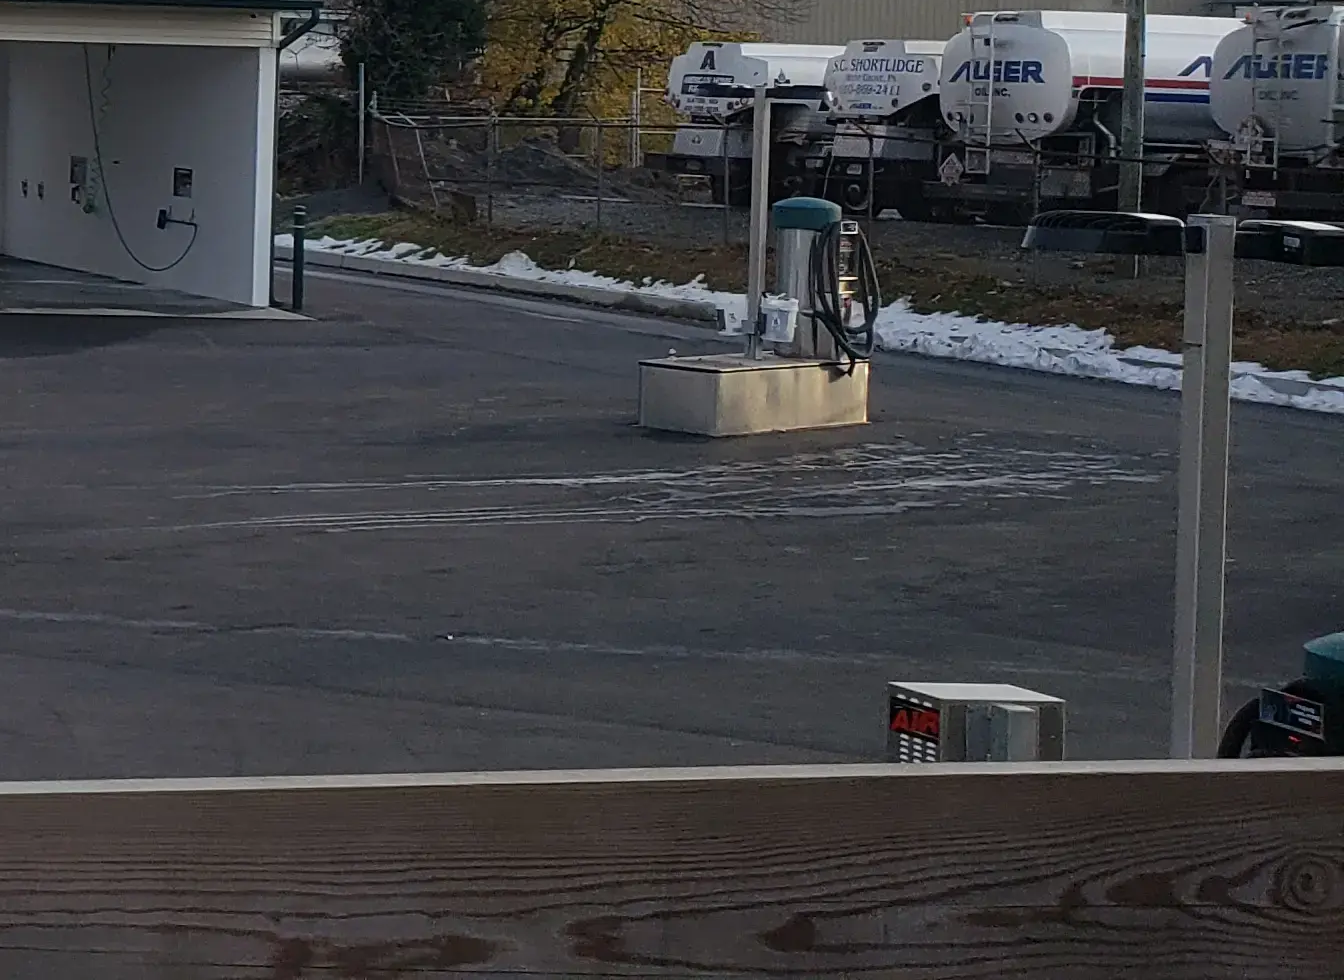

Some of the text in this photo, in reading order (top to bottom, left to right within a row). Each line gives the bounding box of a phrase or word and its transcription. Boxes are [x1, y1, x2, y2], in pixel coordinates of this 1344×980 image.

[700, 48, 716, 70] A
[851, 59, 925, 74] SHORTLIDGE
[949, 61, 1046, 83] AUGER
[891, 709, 939, 733] AIR
